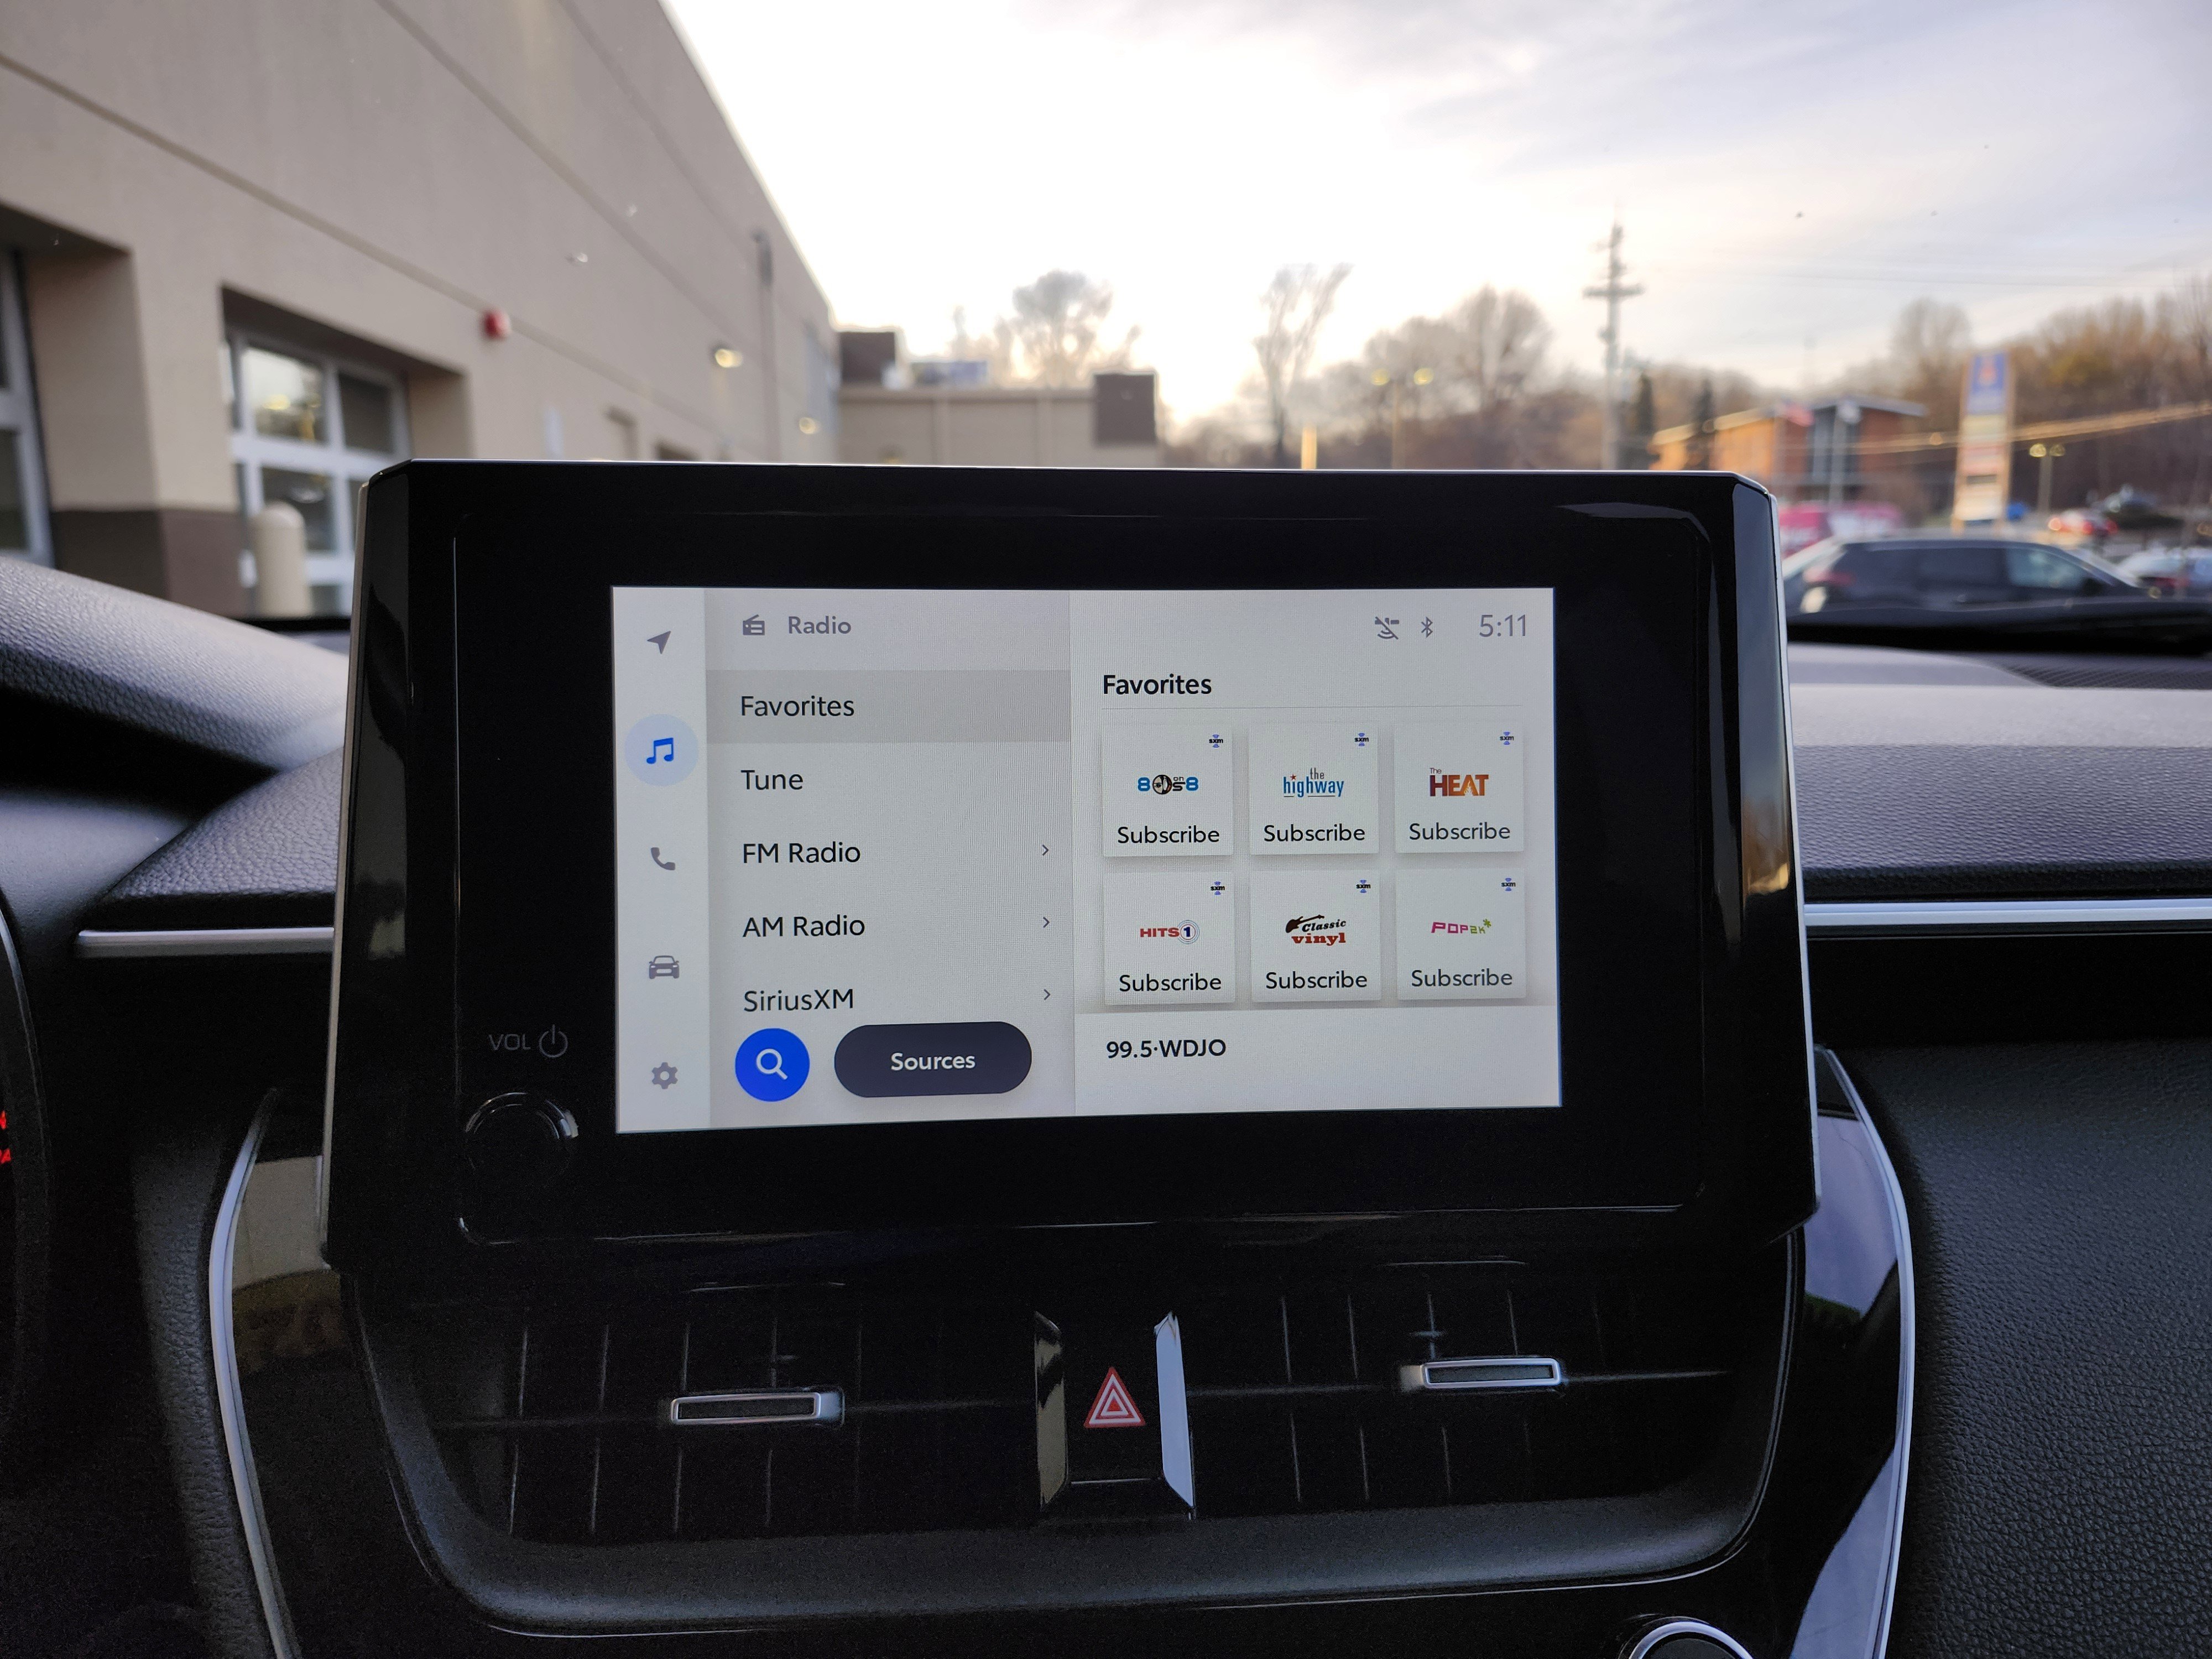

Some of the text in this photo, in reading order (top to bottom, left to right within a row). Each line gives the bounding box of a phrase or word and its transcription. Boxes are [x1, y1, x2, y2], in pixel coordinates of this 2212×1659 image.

[787, 614, 852, 635] Radio
[1479, 614, 1526, 638] 5:11
[1103, 672, 1212, 696] Favorites
[740, 695, 855, 718] Favorites
[740, 769, 804, 791] Tune
[1310, 767, 1324, 780] the
[1283, 774, 1344, 798] highway
[1430, 774, 1489, 796] HEAT
[1117, 824, 1220, 844] Subscribe
[1263, 822, 1366, 843] Subscribe
[1408, 821, 1511, 841] Subscribe
[743, 841, 861, 864] FM Radio
[742, 914, 865, 938] AM Radio
[1301, 919, 1347, 932] Classic
[1291, 932, 1346, 946] vinyl
[1119, 972, 1222, 993] Subscribe
[1265, 969, 1368, 990] Subscribe
[1411, 967, 1513, 988] Subscribe
[743, 988, 854, 1013] SiriusXM
[488, 1034, 531, 1051] VOL
[890, 1052, 976, 1071] Sources
